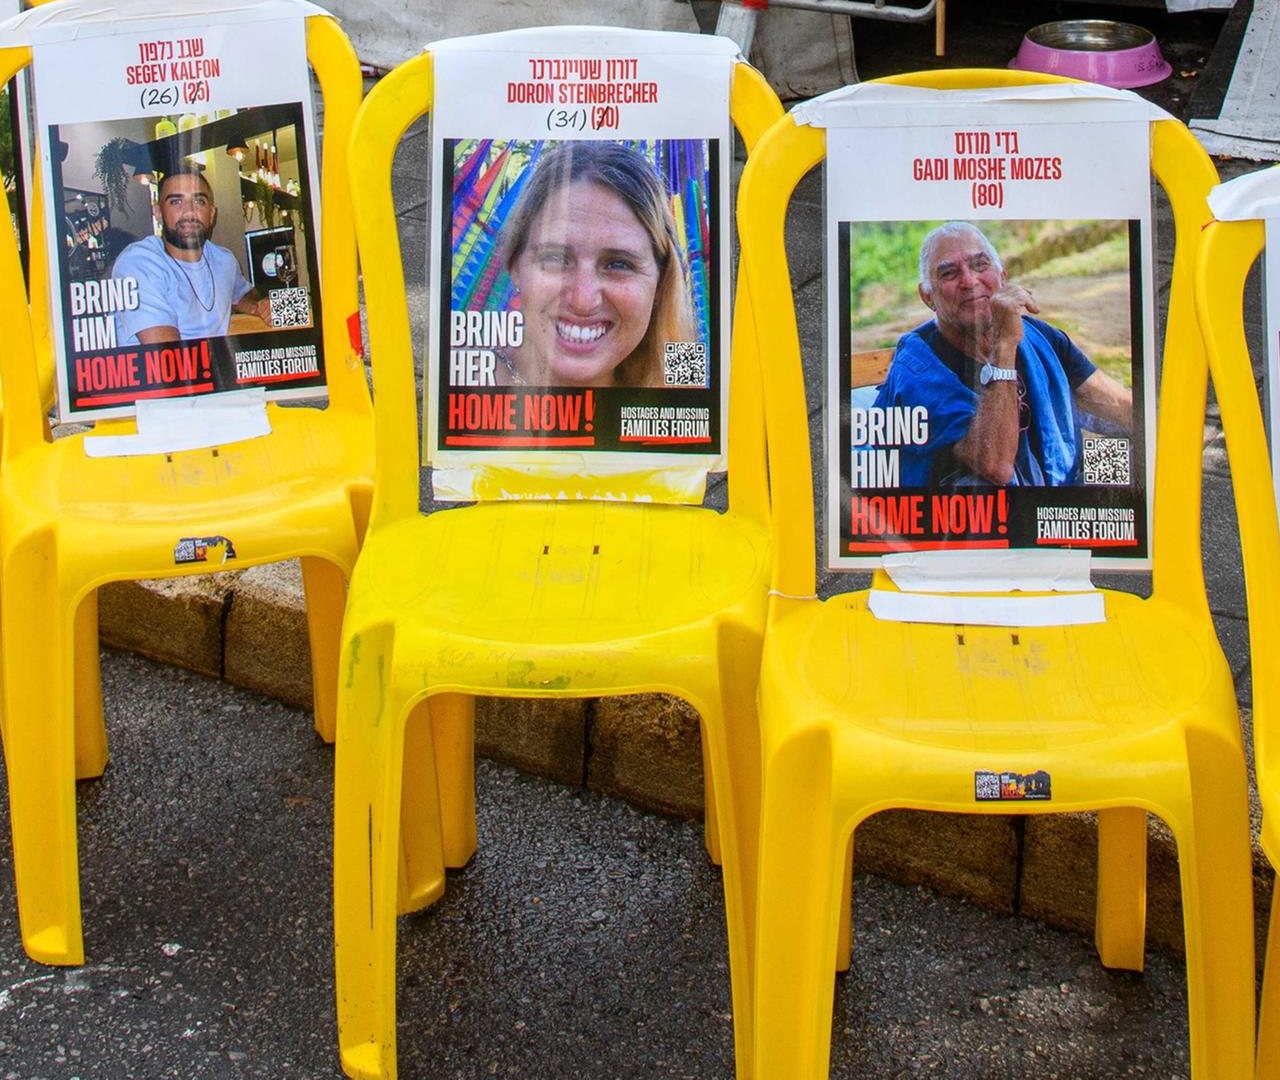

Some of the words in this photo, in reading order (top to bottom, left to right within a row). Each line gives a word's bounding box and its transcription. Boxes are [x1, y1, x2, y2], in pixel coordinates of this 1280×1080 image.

[138, 39, 174, 64] כלפון
[178, 37, 204, 58] שגב
[126, 64, 167, 87] SEGEV
[170, 58, 220, 82] KALFON
[529, 59, 602, 81] שטיינברכר
[604, 58, 638, 84] דורון
[140, 87, 180, 108] (26)
[183, 80, 210, 104] (25)
[507, 83, 555, 104] DORON
[558, 83, 658, 104] STEINBRECHER
[546, 109, 588, 131] (31)
[590, 106, 620, 130] (30)
[955, 132, 991, 155] מוזס
[996, 131, 1020, 154] גדי
[913, 159, 949, 181] GADI
[953, 158, 1006, 180] MOSHE
[1010, 157, 1062, 180] MOZES
[971, 184, 1004, 208] (80)
